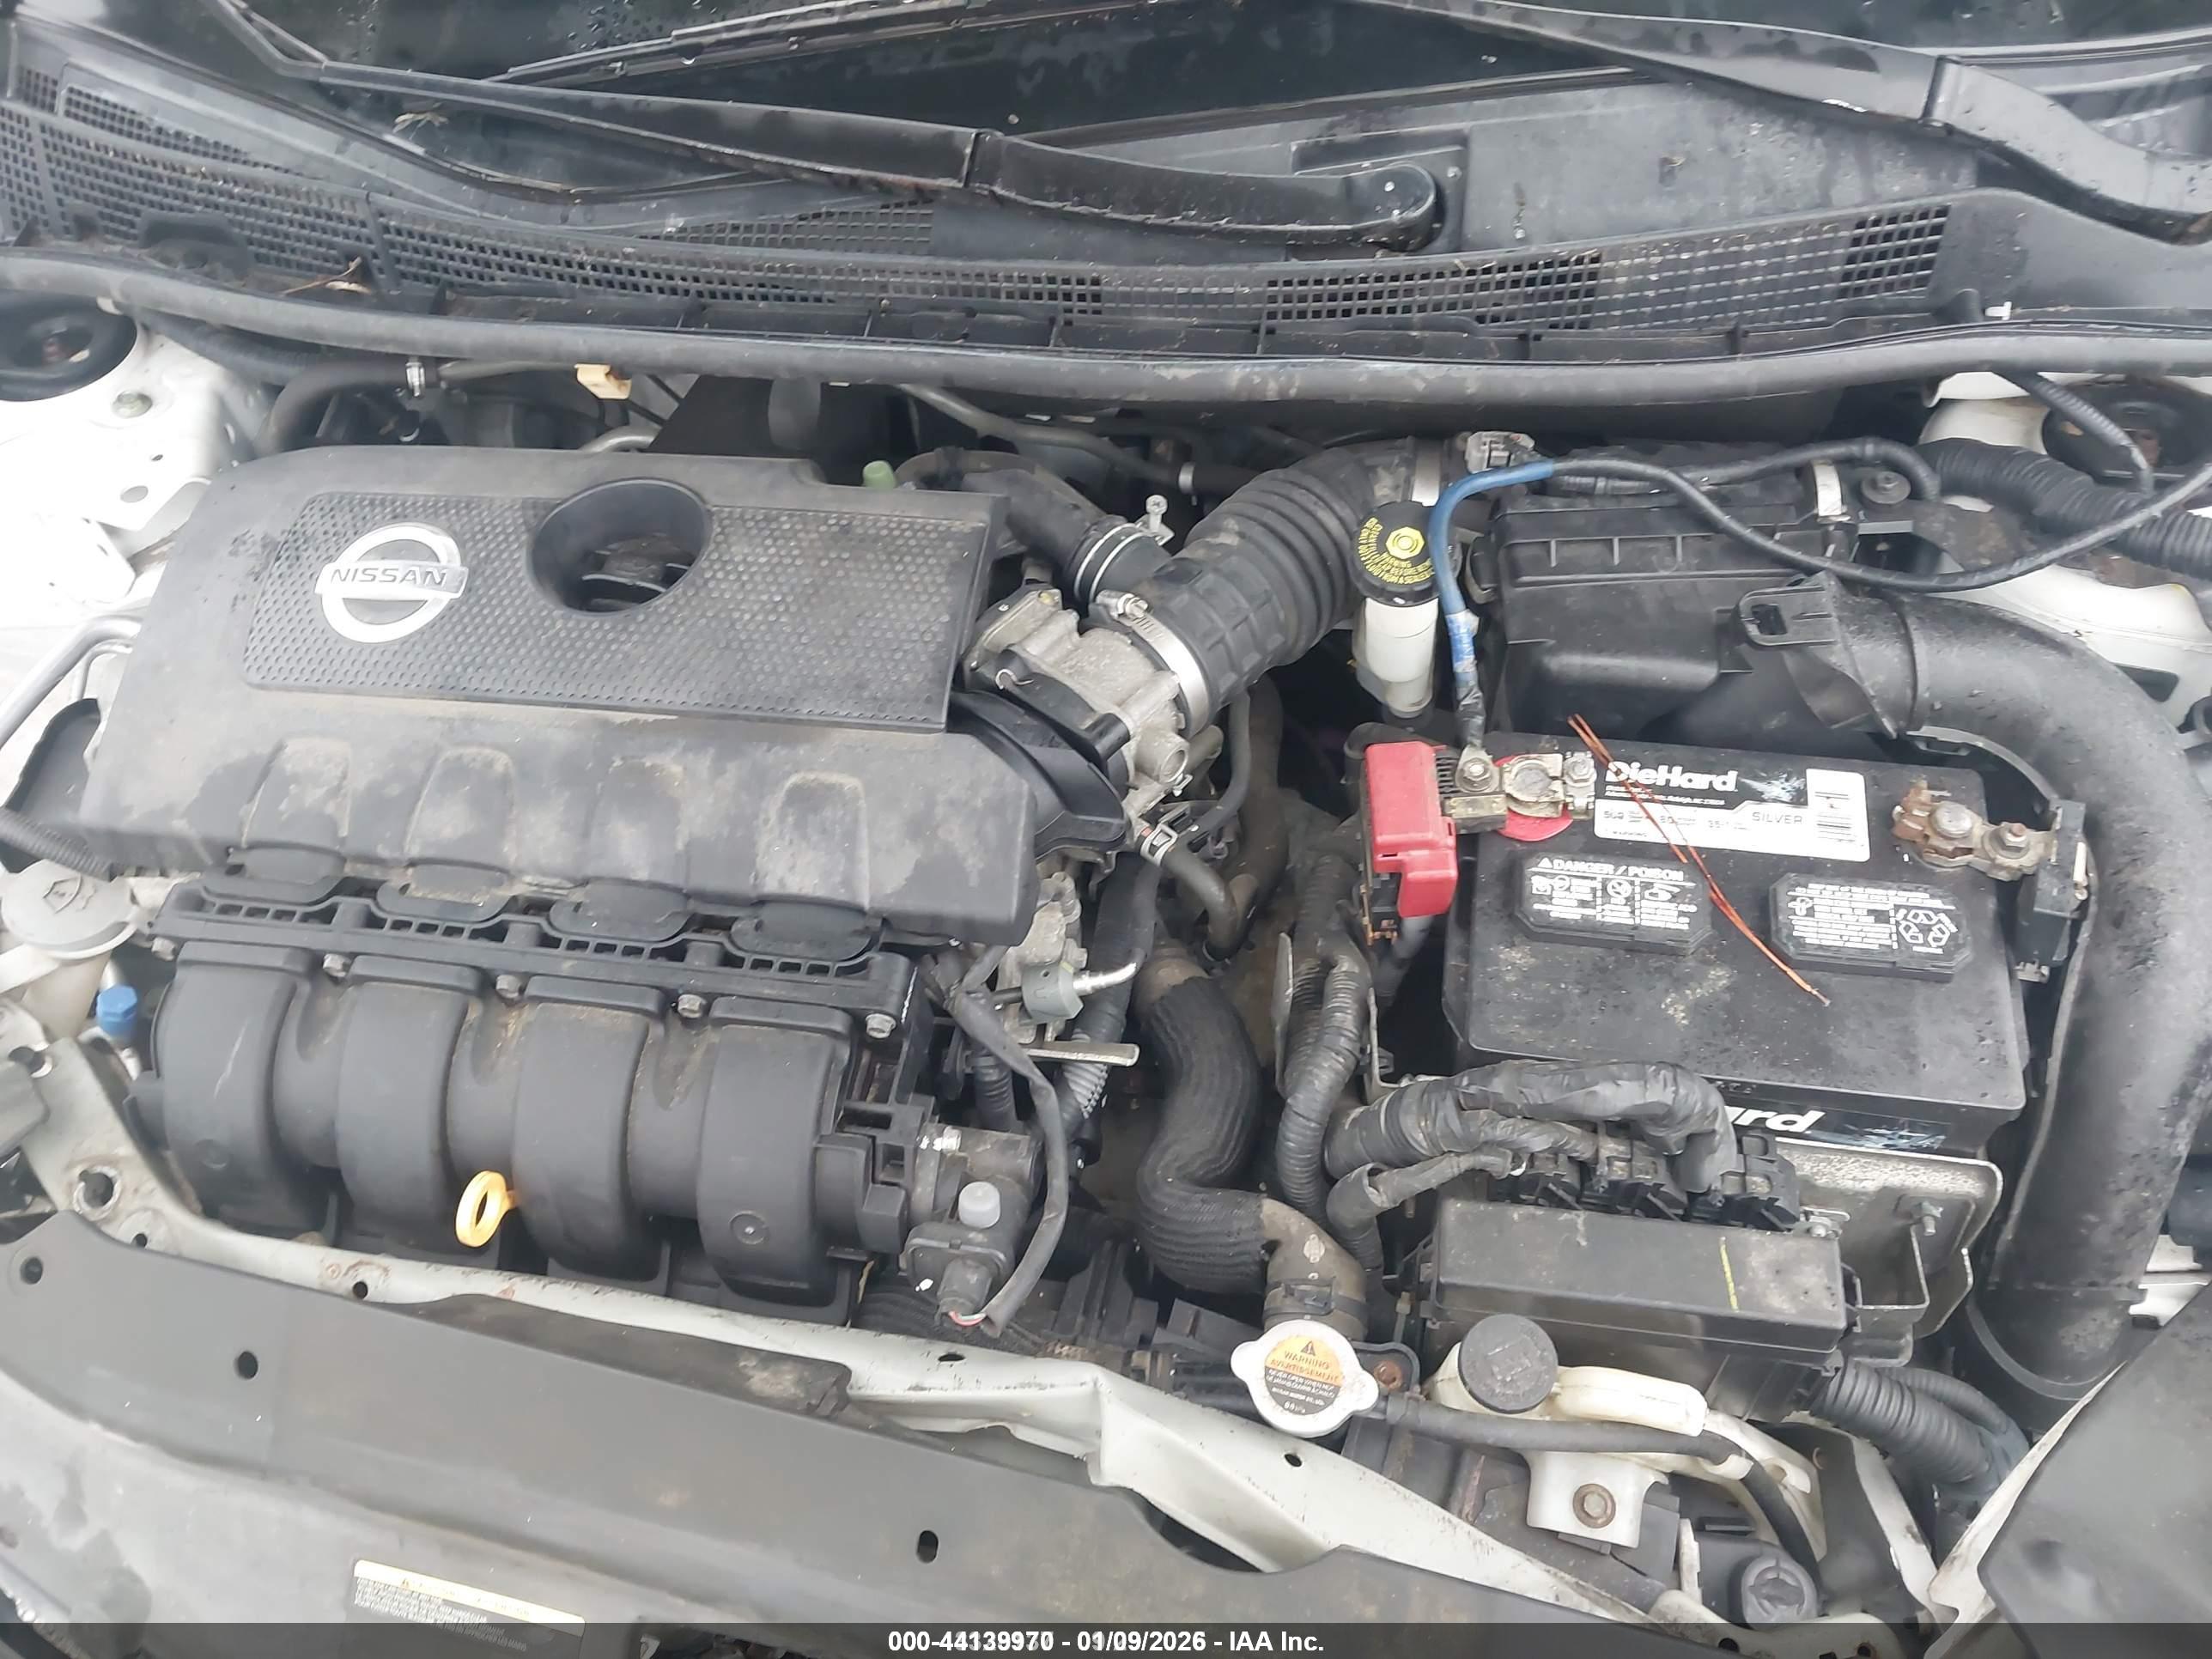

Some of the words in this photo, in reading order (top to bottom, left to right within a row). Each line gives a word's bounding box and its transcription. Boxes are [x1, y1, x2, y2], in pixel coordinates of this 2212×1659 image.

[330, 566, 448, 587] NISSAN
[1605, 761, 1739, 793] DieHard
[1752, 811, 1803, 825] SILVER
[1553, 859, 1615, 875] DANGER
[1627, 866, 1684, 882] POISON
[1284, 1350, 1330, 1370] WARNING
